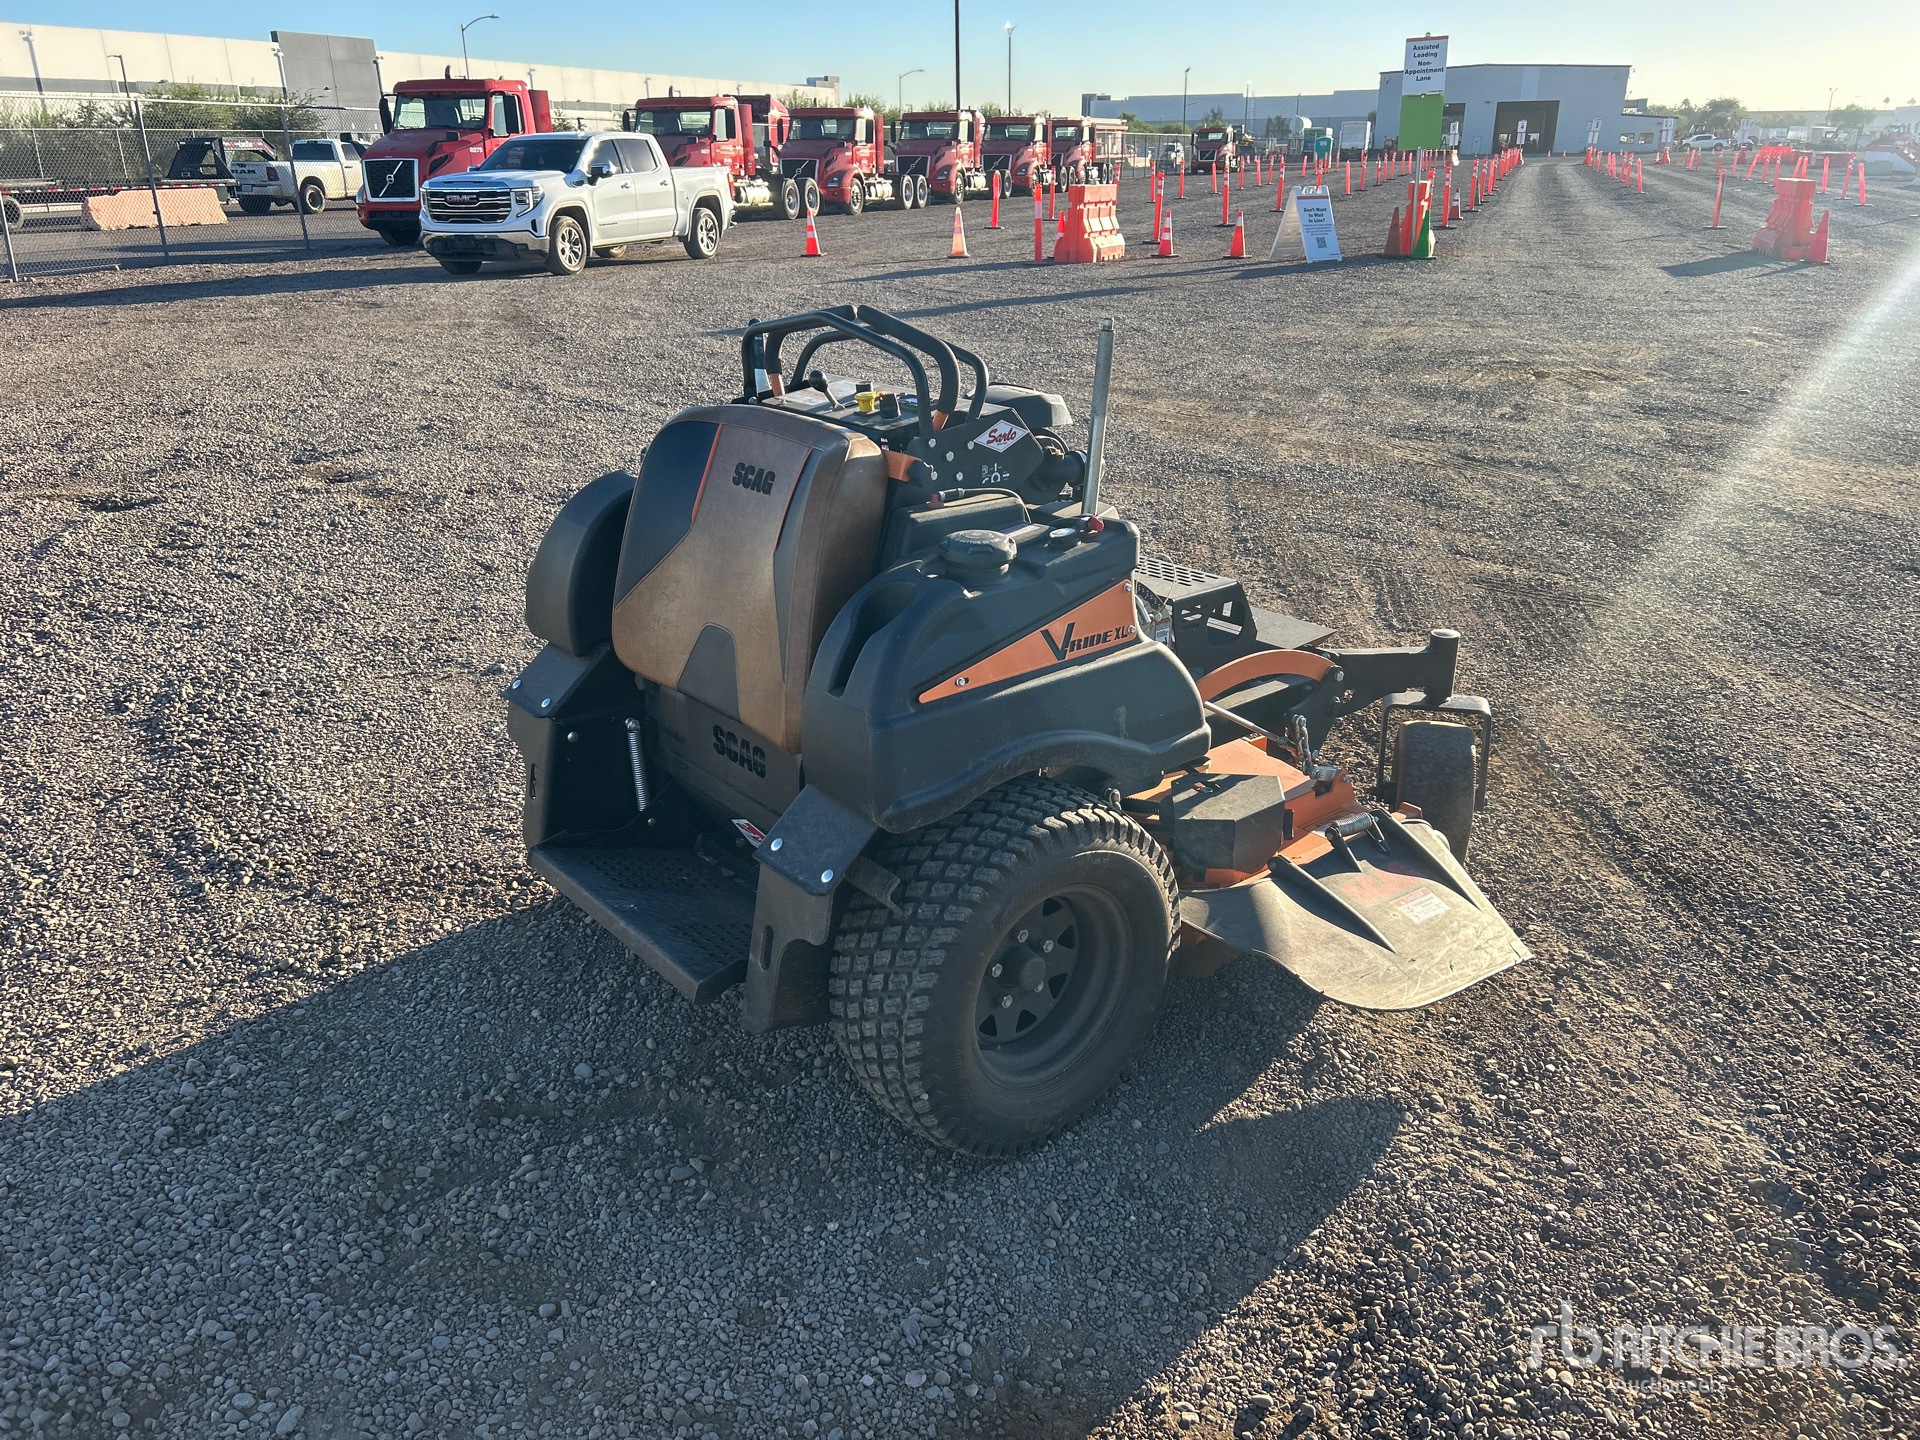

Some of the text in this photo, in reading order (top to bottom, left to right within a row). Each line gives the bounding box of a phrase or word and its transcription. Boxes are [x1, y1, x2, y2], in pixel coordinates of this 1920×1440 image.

[1412, 43, 1440, 51] Assisted
[1404, 67, 1444, 76] Appointment
[445, 194, 478, 203] GMC
[986, 427, 1017, 445] Sarlo
[732, 461, 776, 496] SCAG
[712, 724, 767, 779] SCAG
